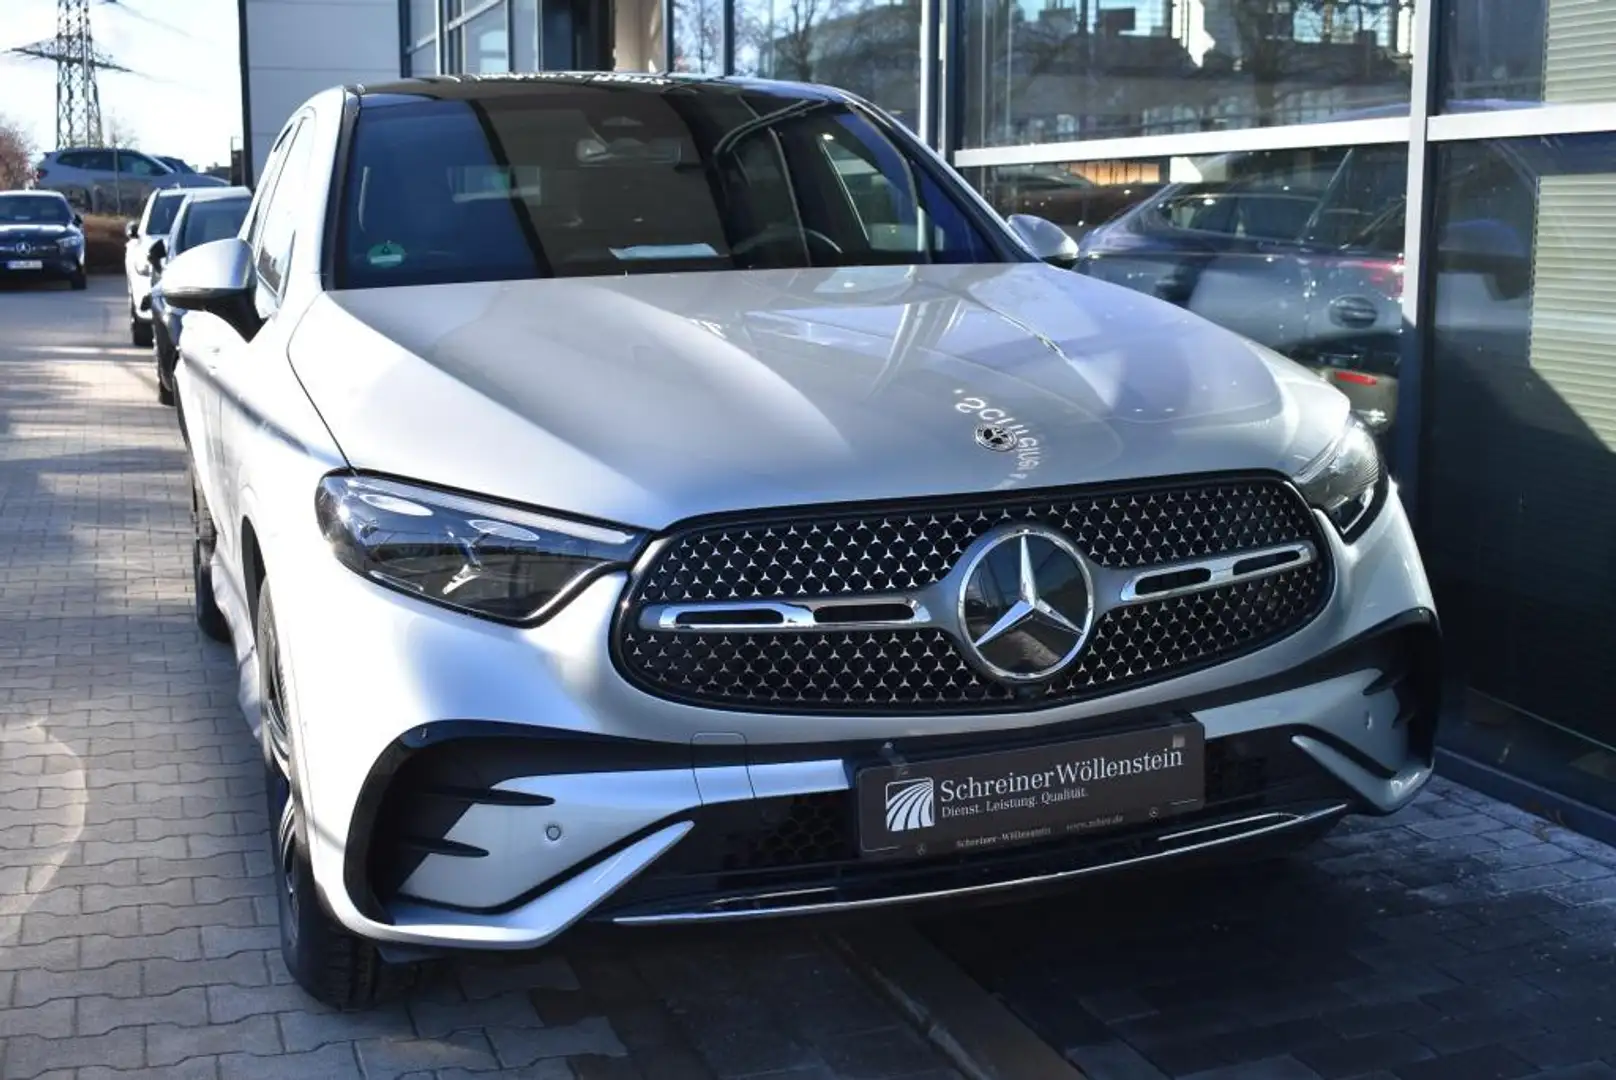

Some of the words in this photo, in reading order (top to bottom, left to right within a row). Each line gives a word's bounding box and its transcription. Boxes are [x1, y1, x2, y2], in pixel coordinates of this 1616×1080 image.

[941, 804, 984, 818] Dienst.
[986, 796, 1037, 812] Leistung.
[1041, 787, 1088, 805] Qualität.
